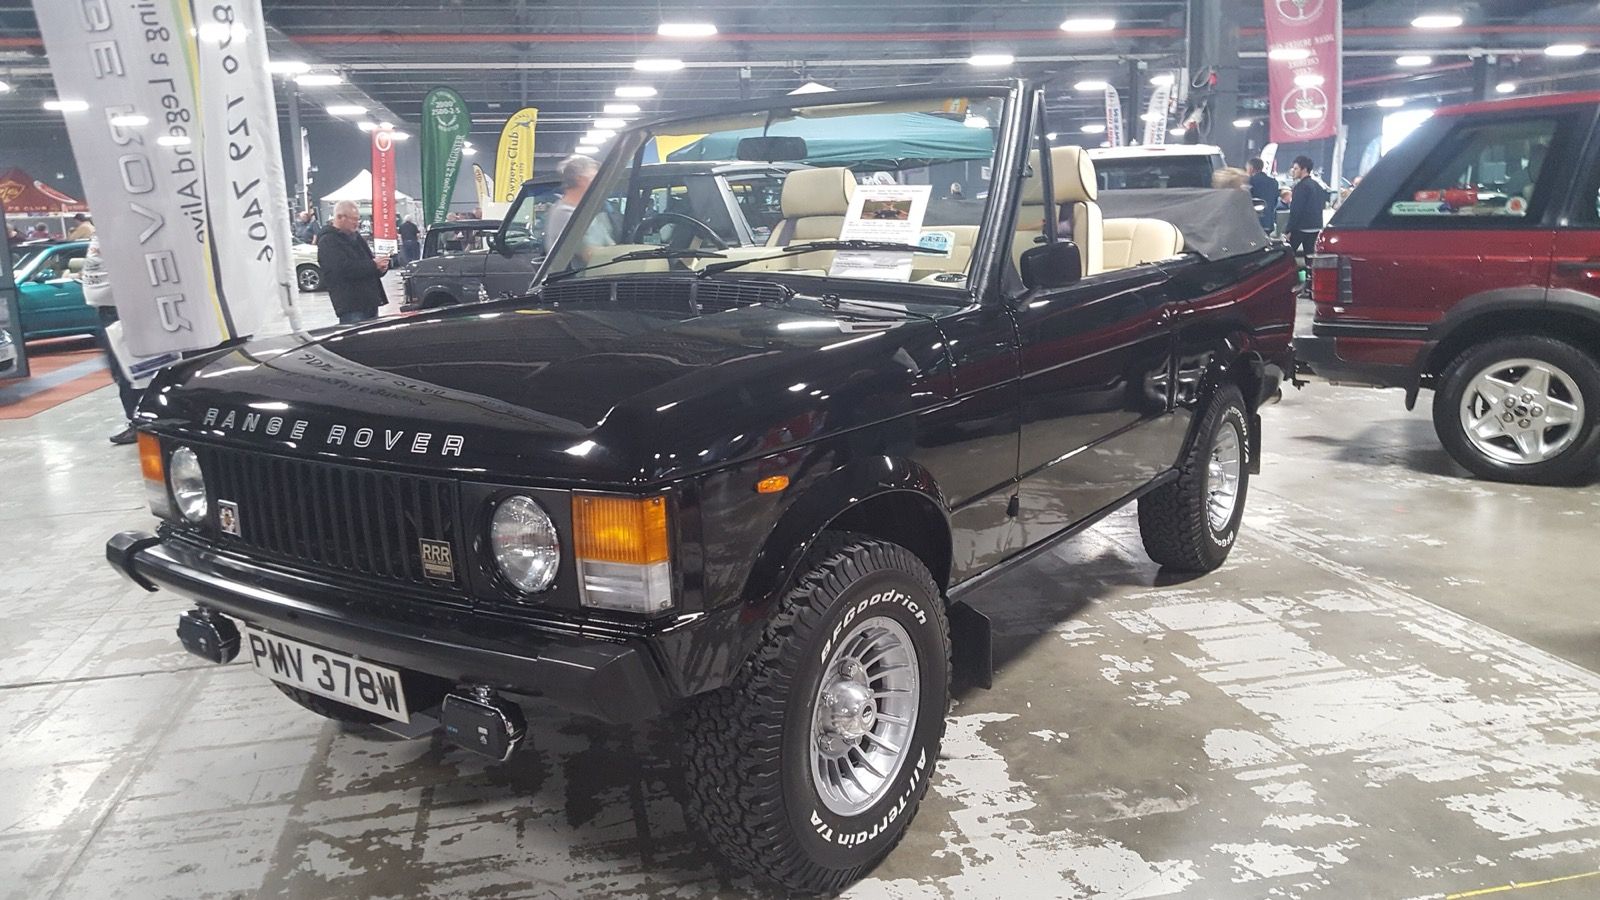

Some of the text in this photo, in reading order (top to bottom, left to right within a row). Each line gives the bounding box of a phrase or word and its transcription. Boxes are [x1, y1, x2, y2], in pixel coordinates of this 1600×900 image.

[446, 134, 466, 167] REGISTER
[505, 131, 520, 203] Owners Club
[203, 407, 465, 458] RANGE ROVER
[421, 543, 450, 562] RRR
[820, 588, 928, 665] BFGoodrich
[251, 630, 401, 714] PMV 378W
[808, 746, 927, 849] All-Terrain T/A
